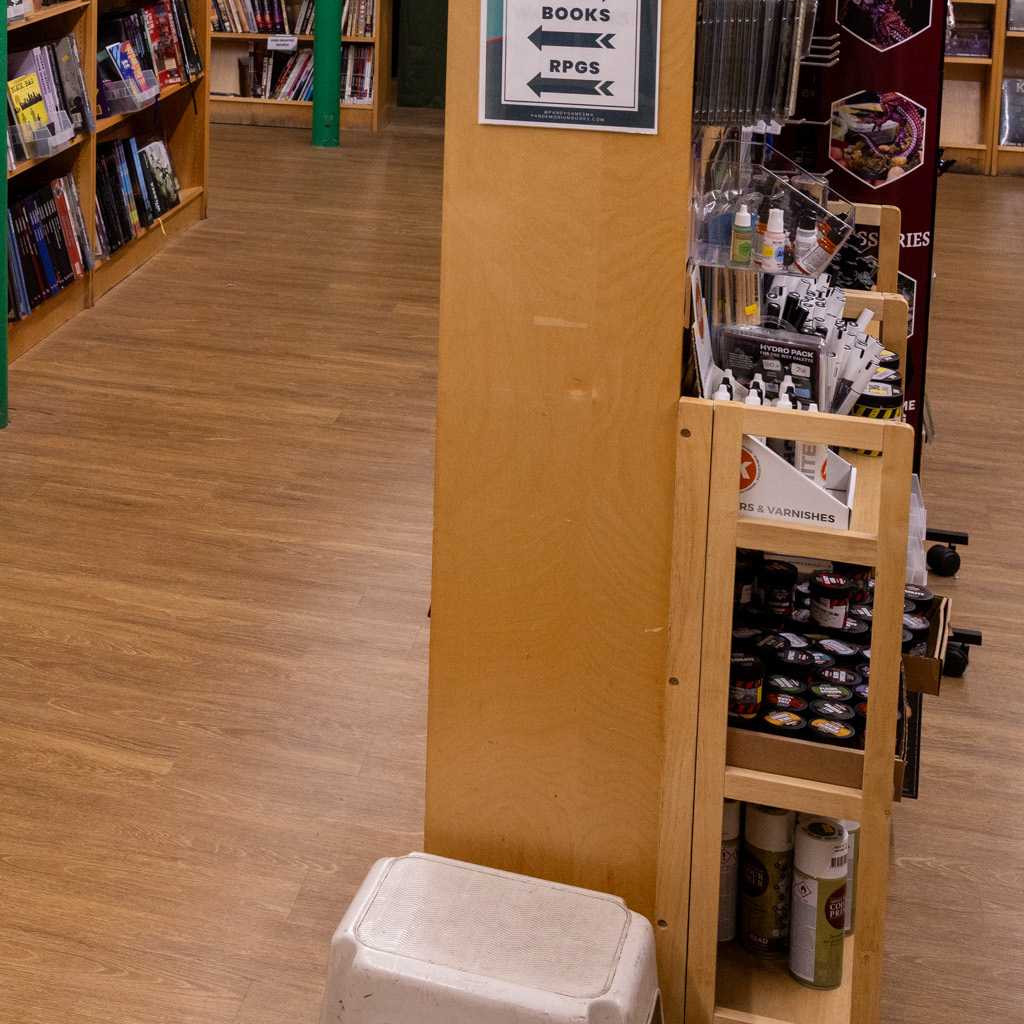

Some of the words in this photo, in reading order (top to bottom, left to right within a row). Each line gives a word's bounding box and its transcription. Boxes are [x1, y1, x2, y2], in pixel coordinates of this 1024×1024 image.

[542, 7, 610, 21] BOOKS
[550, 60, 600, 74] RPGS
[10, 82, 25, 94] BLACK
[25, 78, 35, 87] BAG
[531, 114, 605, 122] PANDEMONIUMBOOKS.COM
[760, 344, 789, 354] HYDRO
[791, 349, 814, 358] PACK
[757, 505, 765, 513] &
[768, 507, 835, 523] VARNISHES
